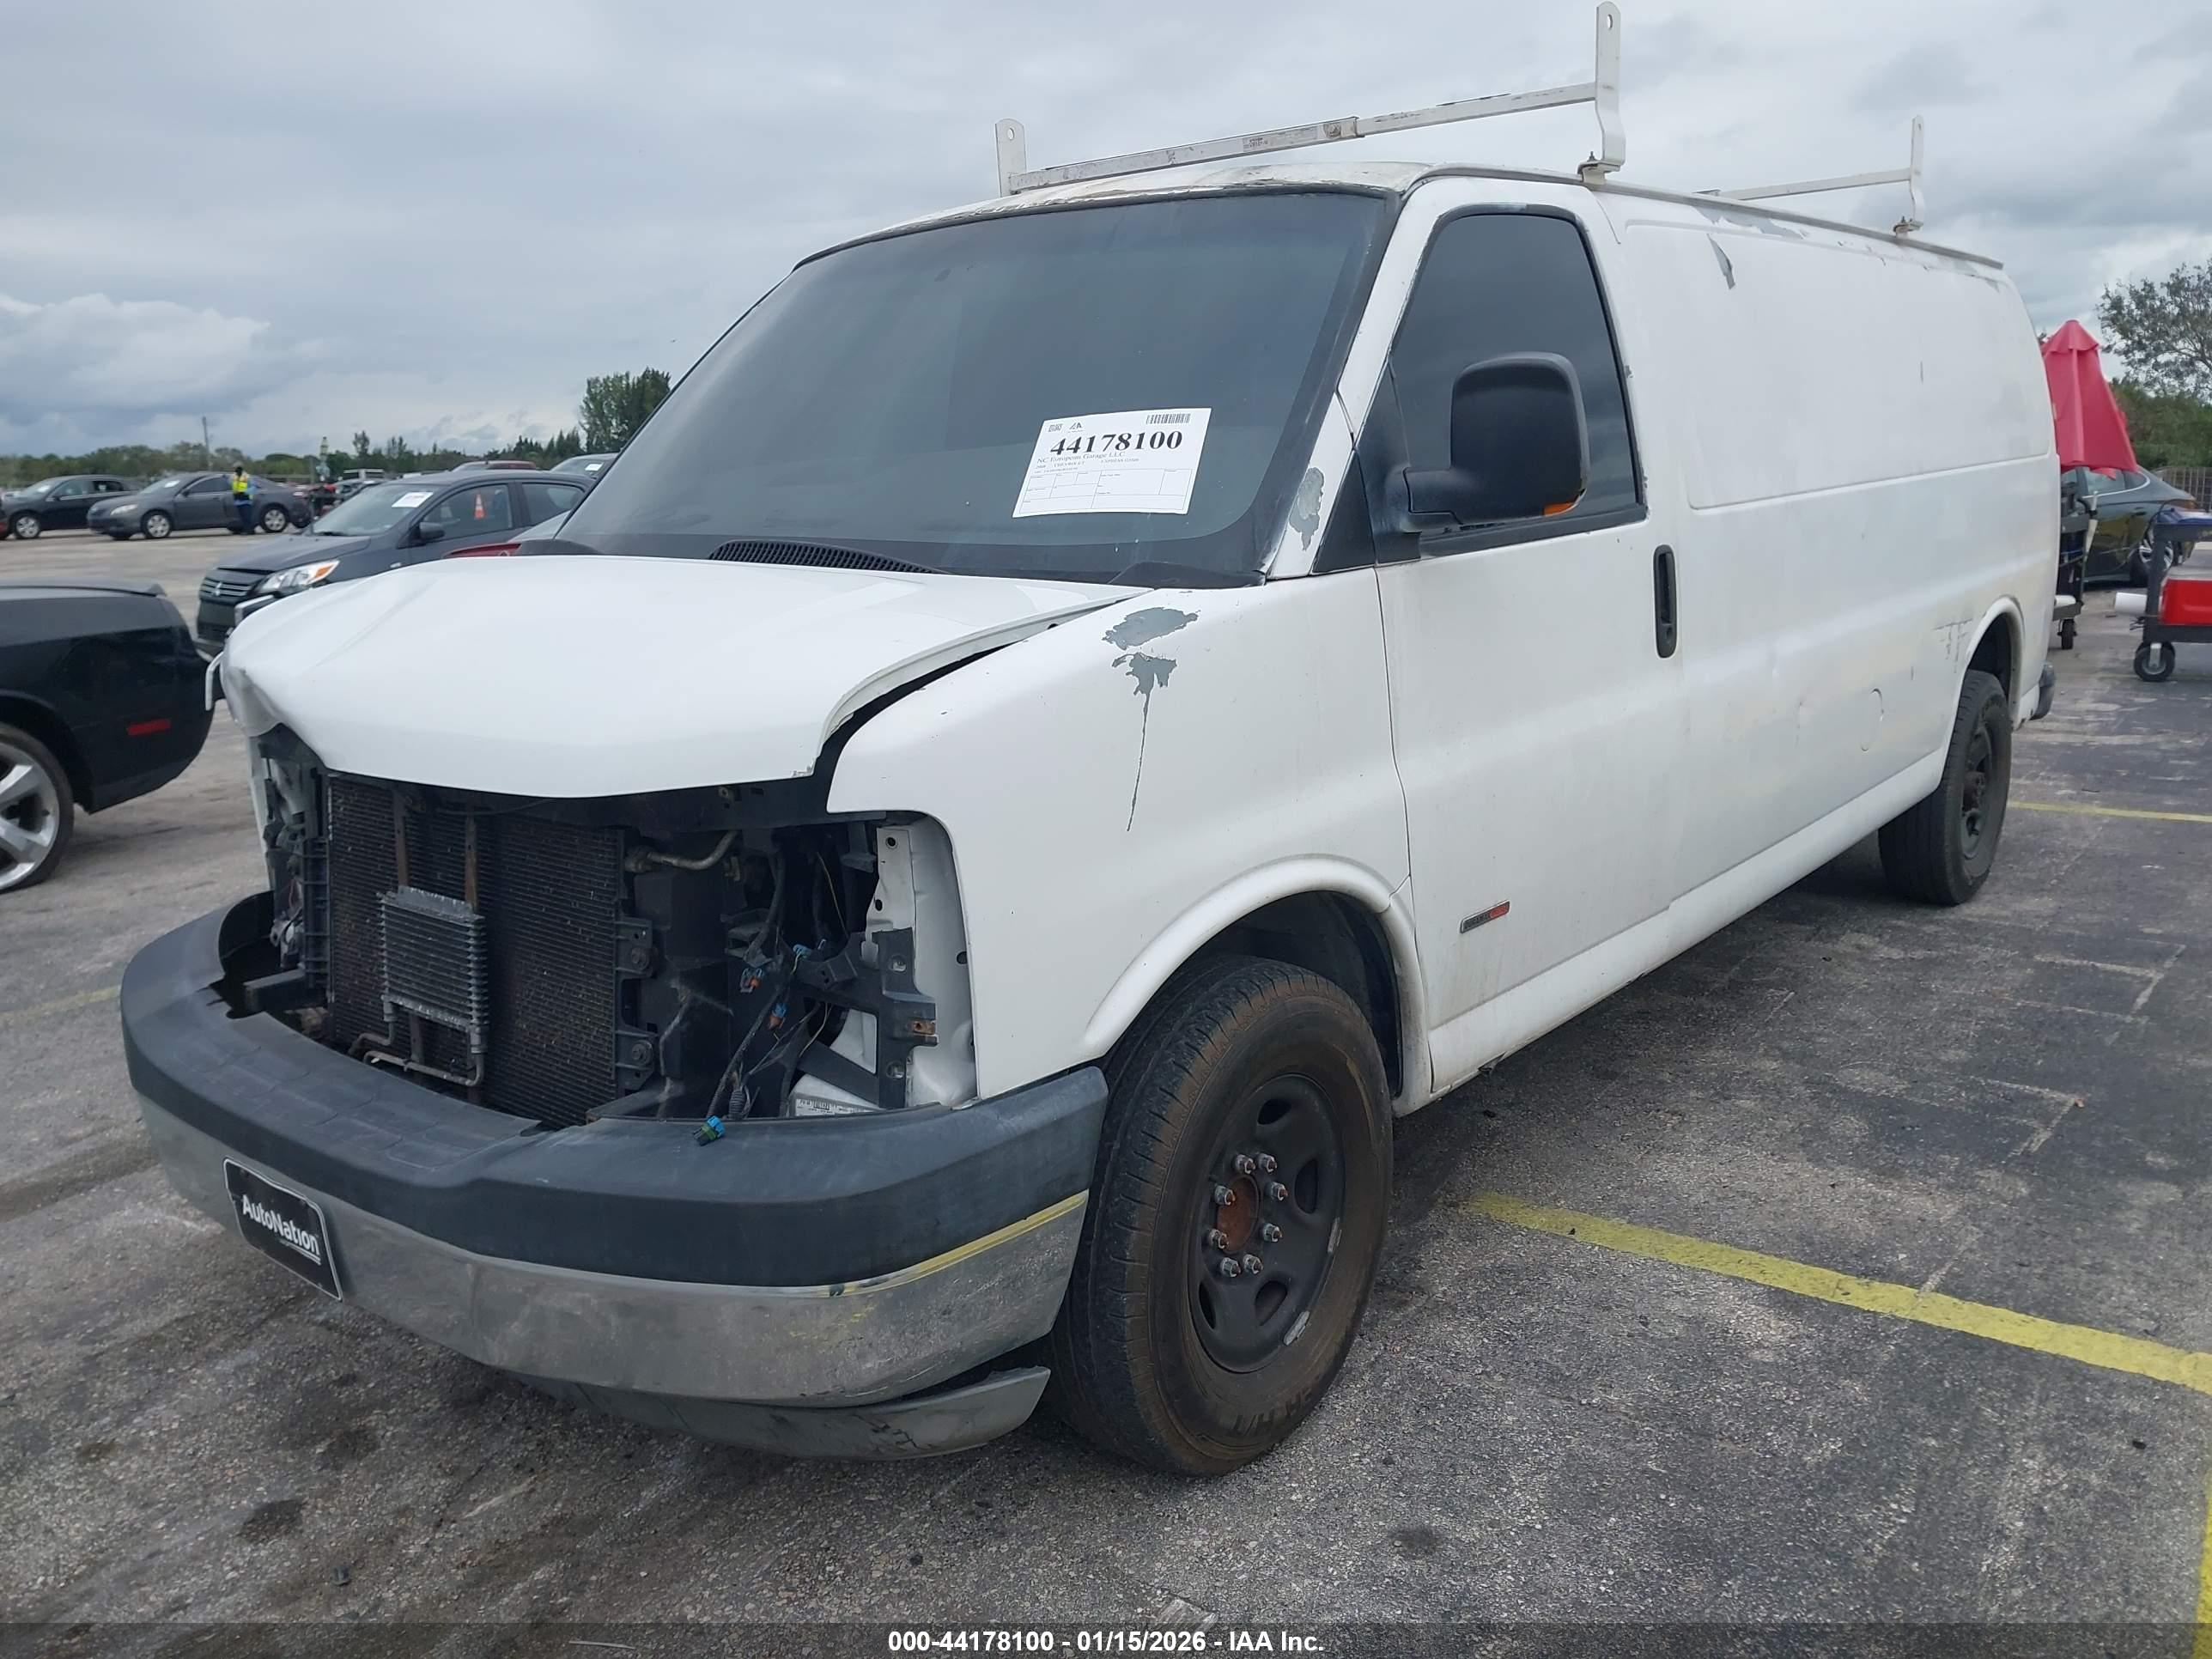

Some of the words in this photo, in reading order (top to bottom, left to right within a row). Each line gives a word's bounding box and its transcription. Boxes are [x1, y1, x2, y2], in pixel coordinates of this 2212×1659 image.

[1050, 430, 1182, 455] 44178100
[1050, 454, 1081, 463] European
[242, 1194, 320, 1255] AutoNation
